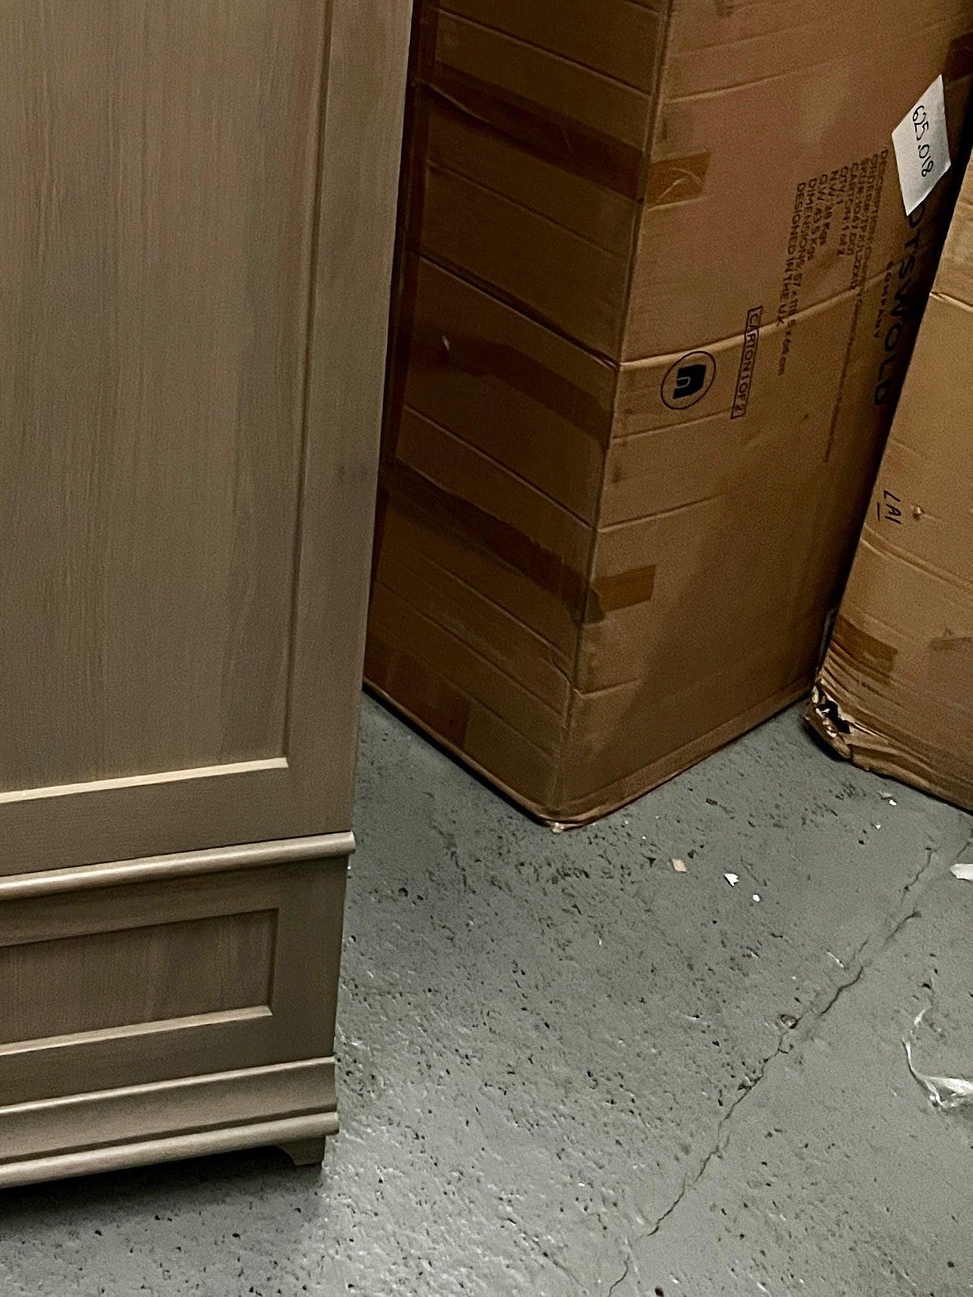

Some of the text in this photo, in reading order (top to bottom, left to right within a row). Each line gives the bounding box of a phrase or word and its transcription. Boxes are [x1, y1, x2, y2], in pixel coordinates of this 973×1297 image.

[875, 203, 926, 406] OTSWOLD
[740, 312, 760, 375] CARTON
[737, 382, 748, 402] OF
